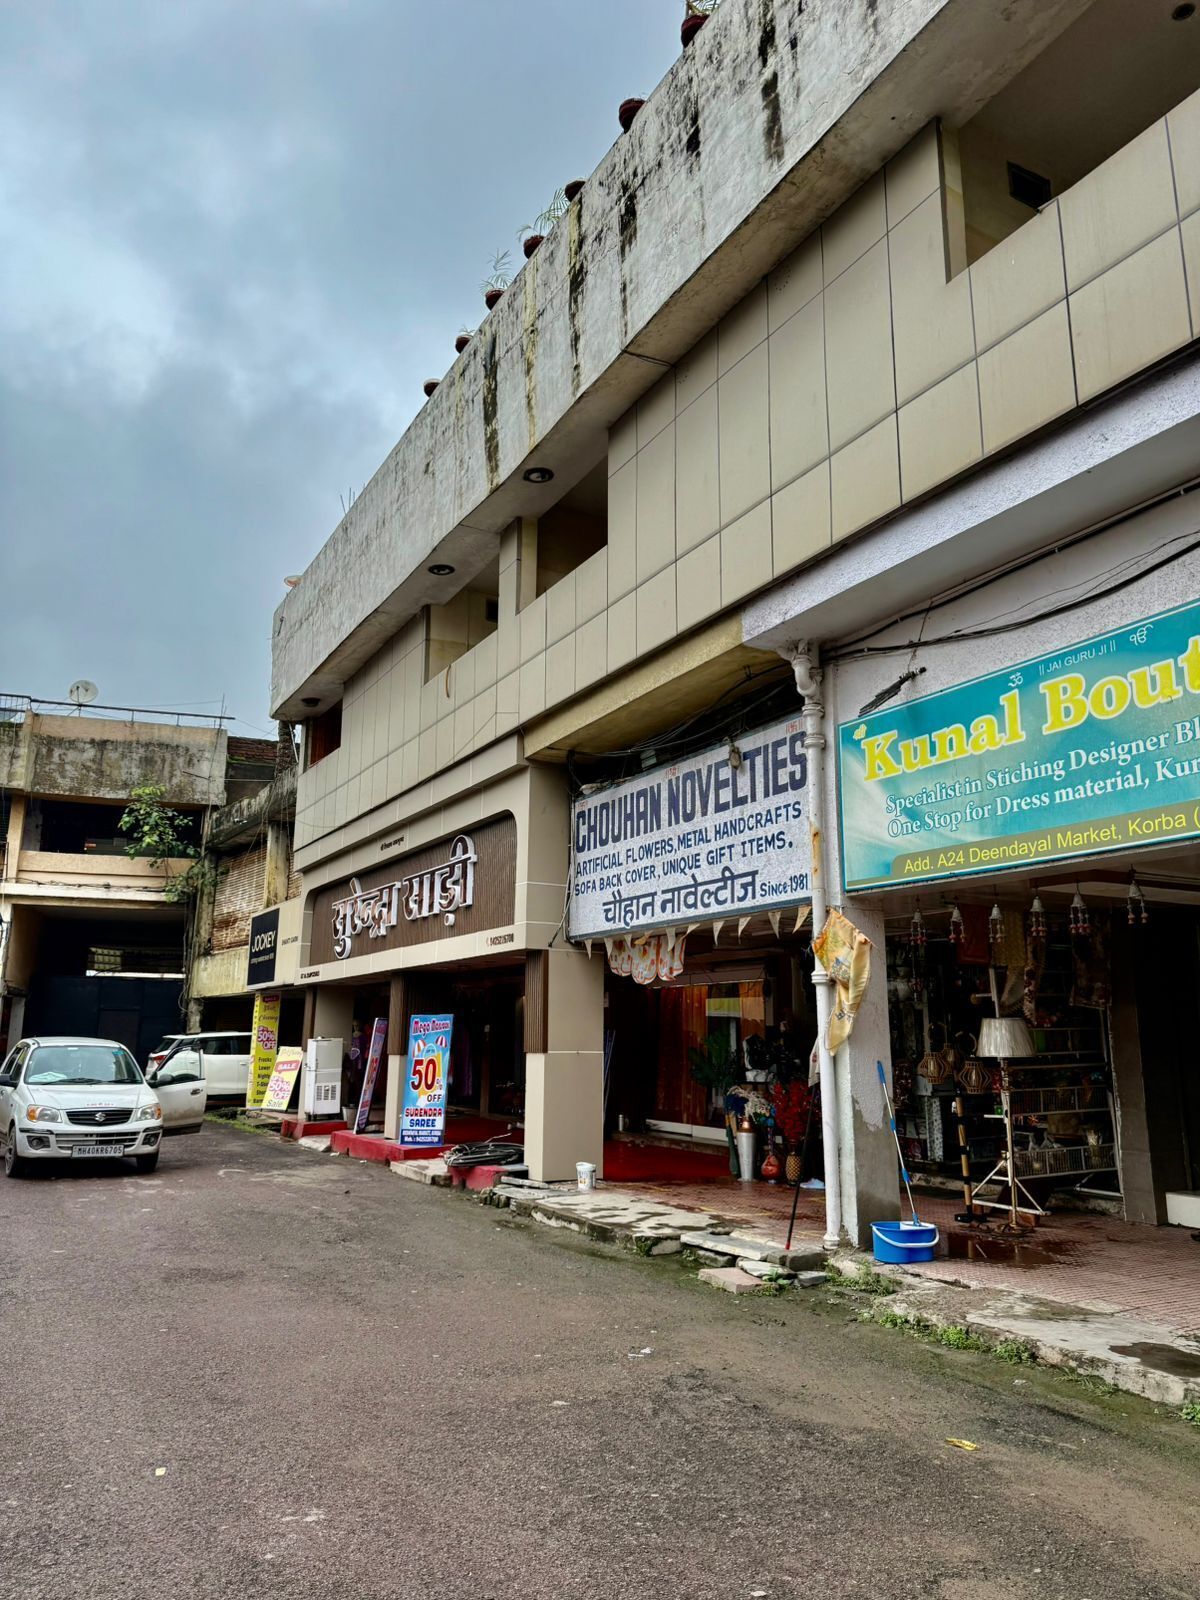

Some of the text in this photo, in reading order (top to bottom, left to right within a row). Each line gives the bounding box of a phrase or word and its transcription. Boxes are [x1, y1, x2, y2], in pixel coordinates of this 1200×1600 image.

[1047, 659, 1061, 673] JAI
[1064, 648, 1095, 666] GURU
[1099, 644, 1107, 656] JI
[861, 634, 1200, 782] Kunal Bout
[576, 731, 807, 854] CHOUHAN NOVELTIES
[885, 779, 961, 816] Specialist
[963, 776, 983, 795] in
[985, 758, 1066, 791] Stiching
[1068, 730, 1170, 771] Designer
[887, 817, 921, 838] One
[924, 809, 962, 832] Stop
[965, 801, 992, 822] for
[994, 791, 1050, 816] Dress
[1054, 764, 1149, 804] material,
[575, 879, 597, 896] SOFA
[600, 873, 622, 891] BACK
[663, 853, 701, 876] UNIQUE
[706, 844, 735, 865] GIFT
[741, 831, 793, 857] ITEMS.
[576, 801, 802, 878] ARTIFICIAL FLOWERS, METAL HANDCRAFTS
[904, 857, 934, 873] Add.
[937, 850, 965, 868] A24
[969, 835, 1051, 863] Deendayal
[1057, 823, 1122, 848] Market,
[1128, 813, 1186, 836] Korba
[602, 889, 657, 927] चौहान
[252, 930, 276, 953] JOCKEY
[264, 1040, 276, 1049] OFF
[405, 1107, 442, 1117] SURENDRA
[409, 1118, 437, 1128] SAREE
[427, 1094, 442, 1103] OFF
